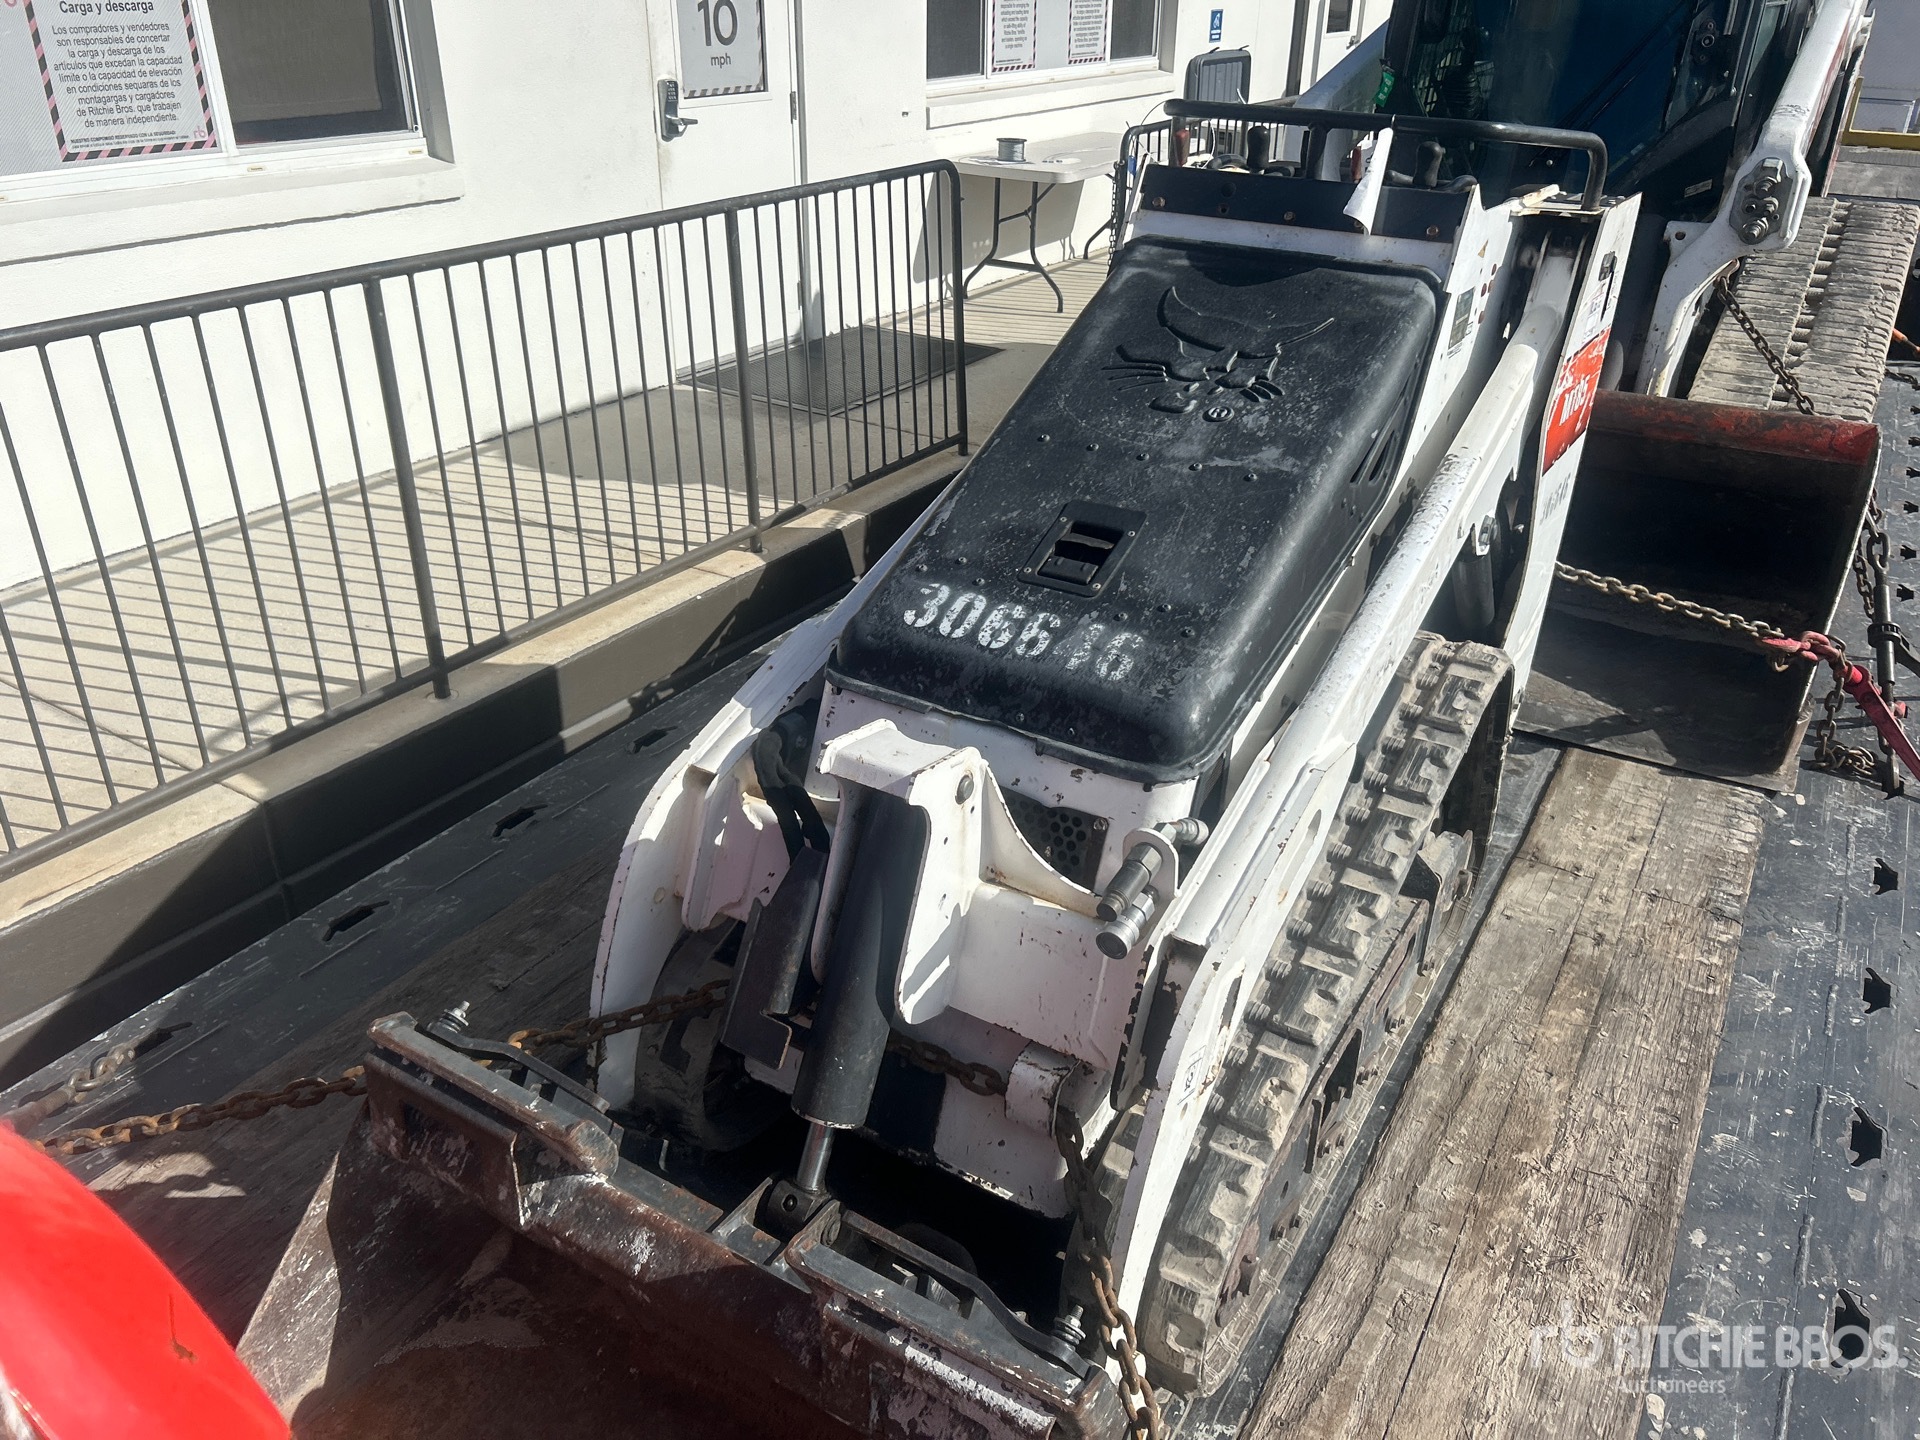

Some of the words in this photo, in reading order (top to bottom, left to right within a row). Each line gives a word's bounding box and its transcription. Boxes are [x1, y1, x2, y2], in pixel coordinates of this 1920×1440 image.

[60, 1, 93, 16] Carga
[95, 3, 102, 15] y
[105, 0, 154, 14] descarga
[52, 25, 67, 35] Los
[69, 23, 119, 36] compradores
[120, 25, 125, 34] y
[127, 22, 170, 32] vendedores
[697, 0, 738, 46] 10
[57, 38, 72, 47] son
[73, 35, 124, 48] responsables
[125, 35, 135, 44] de
[136, 33, 171, 43] concertar
[68, 49, 76, 58] la
[77, 49, 100, 59] carga
[101, 49, 106, 59] y
[107, 47, 142, 58] descarga
[142, 46, 153, 55] de
[154, 44, 165, 54] los
[88, 61, 103, 71] que
[105, 58, 136, 68] excedan
[138, 57, 145, 67] la
[146, 56, 183, 68] capacidad
[710, 53, 732, 69] mph
[89, 72, 97, 81] la
[98, 69, 136, 81] capacidad
[138, 69, 147, 78] de
[66, 87, 77, 95] en
[78, 82, 123, 94] condiciones
[159, 79, 169, 88] de
[170, 78, 182, 87] los
[128, 95, 134, 103] y
[134, 90, 176, 102] cargadores
[76, 108, 87, 117] de
[88, 105, 114, 116] Ritchie
[136, 105, 152, 115] que
[152, 101, 183, 112] trabajen
[84, 119, 95, 128] de
[96, 117, 125, 127] manera
